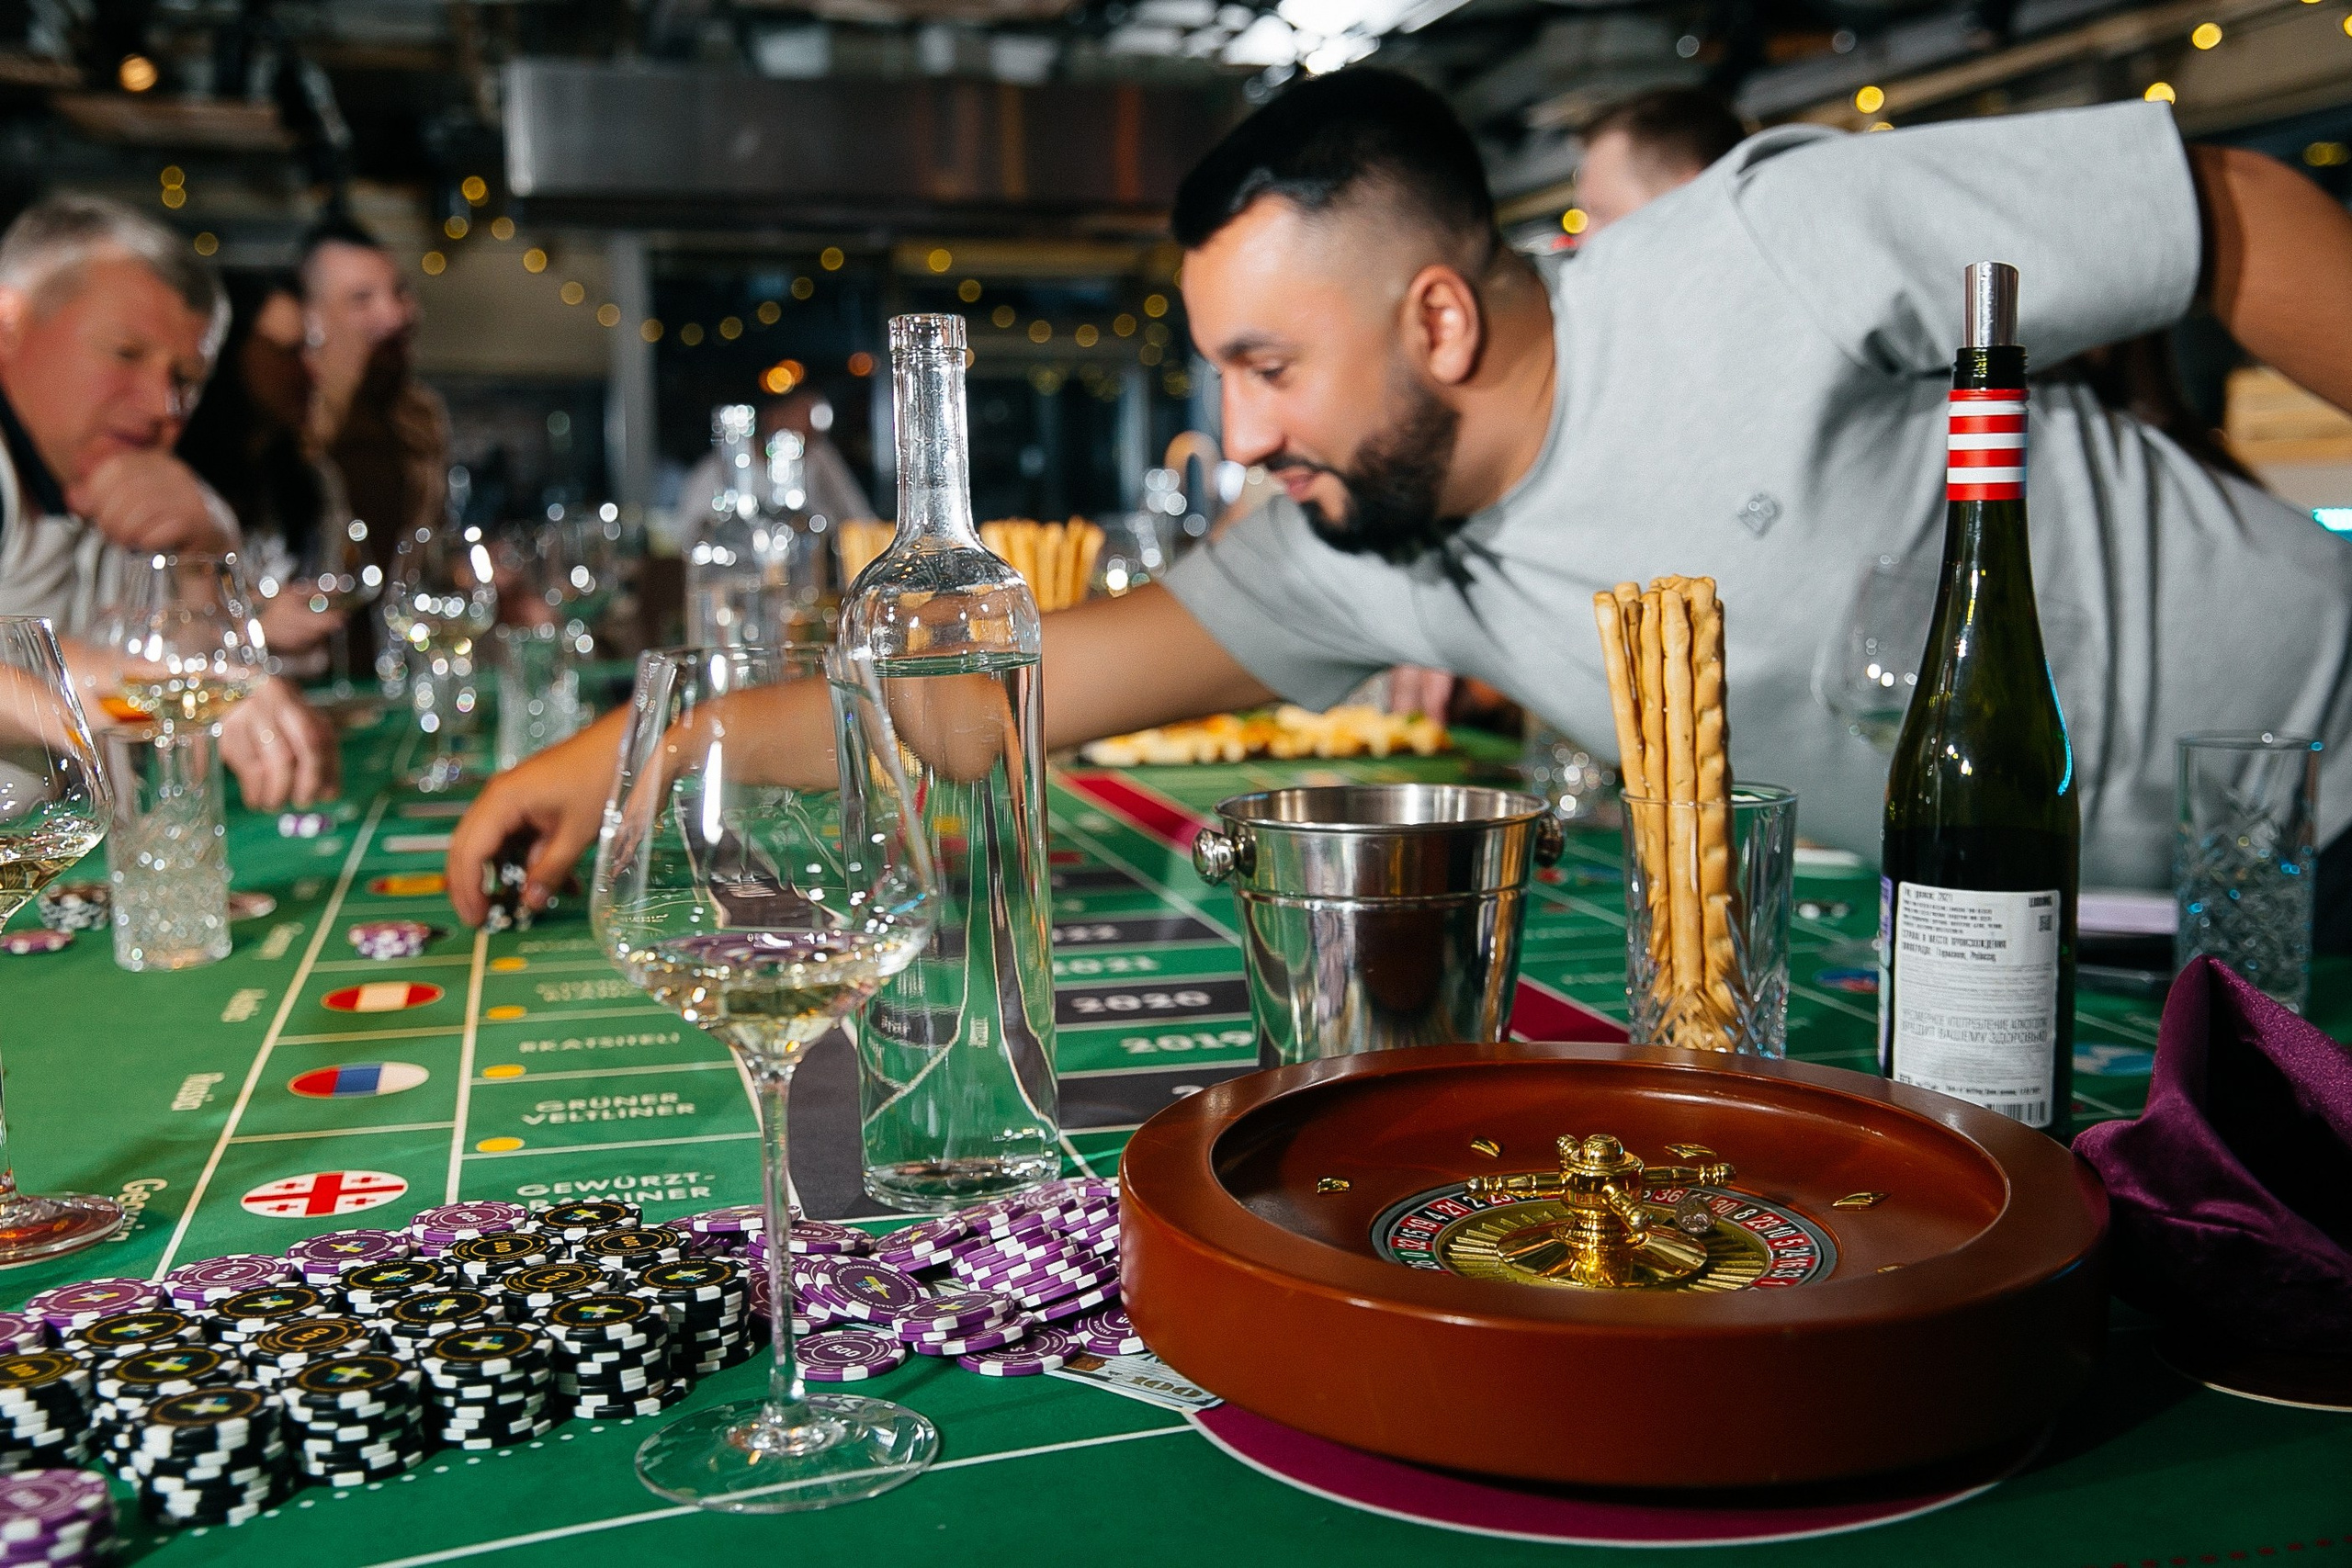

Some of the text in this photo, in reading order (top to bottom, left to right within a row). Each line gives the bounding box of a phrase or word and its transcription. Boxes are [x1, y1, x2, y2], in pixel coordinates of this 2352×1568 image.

[1070, 989, 1211, 1013] 2020
[1120, 1030, 1254, 1054] 2019
[521, 1102, 695, 1126] VELTLINER
[516, 1171, 716, 1197] GEWÜRZT-
[1656, 1189, 1683, 1202] 36
[1436, 1201, 1468, 1216] 21
[1463, 1196, 1485, 1209] 2
[1711, 1200, 1737, 1214] 30
[1424, 1210, 1449, 1221] 4
[1734, 1209, 1758, 1220] 8
[1407, 1218, 1437, 1231] 19
[1747, 1215, 1781, 1230] 23
[1401, 1228, 1430, 1240] 15
[1764, 1226, 1796, 1239] 10
[494, 1241, 513, 1253] 100
[619, 1235, 642, 1248] 100
[1396, 1238, 1427, 1250] 32
[1774, 1237, 1804, 1247] 5
[1780, 1247, 1811, 1258] 24
[1777, 1258, 1808, 1269] 16
[213, 1266, 248, 1280] 500
[536, 1271, 571, 1284] 100
[292, 1327, 331, 1343] 100
[827, 1345, 861, 1358] 500
[1130, 1376, 1204, 1398] 100
